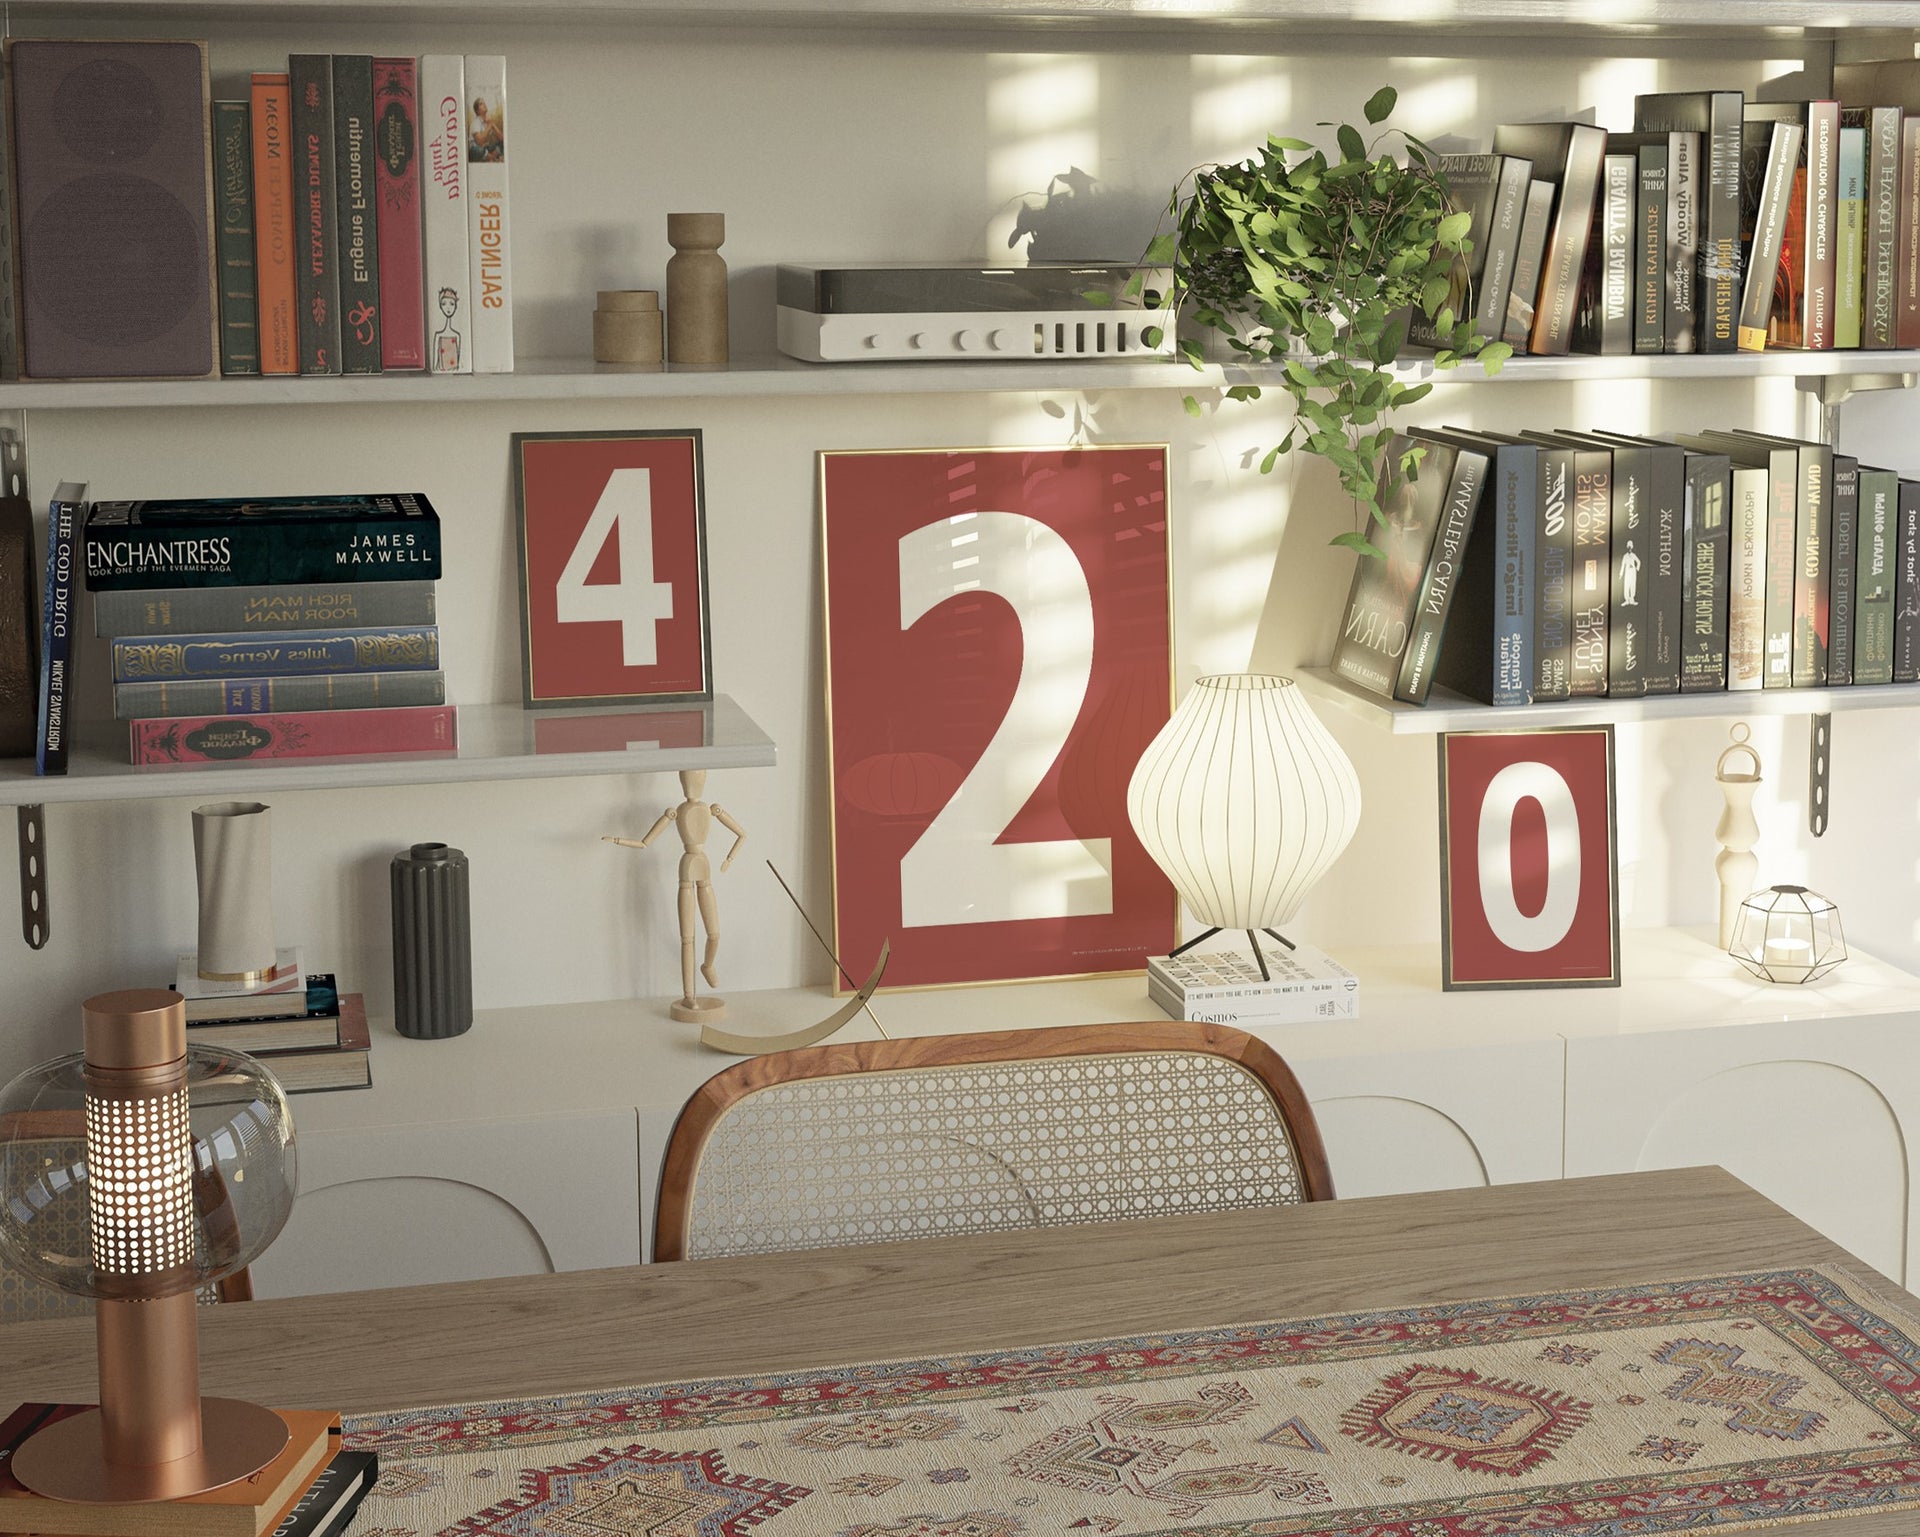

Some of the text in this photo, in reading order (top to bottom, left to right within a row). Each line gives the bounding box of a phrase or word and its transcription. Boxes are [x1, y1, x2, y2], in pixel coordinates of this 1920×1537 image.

[87, 537, 231, 568] ENCHANTRESS
[349, 533, 416, 548] JAMES
[335, 548, 432, 565] MAXWELL
[556, 468, 674, 667] 4
[114, 564, 232, 575] ONE OF THE EVERMEN SAGA
[899, 511, 1113, 929] 2
[1478, 761, 1581, 952] 0
[1191, 1011, 1238, 1022] Cosmos
